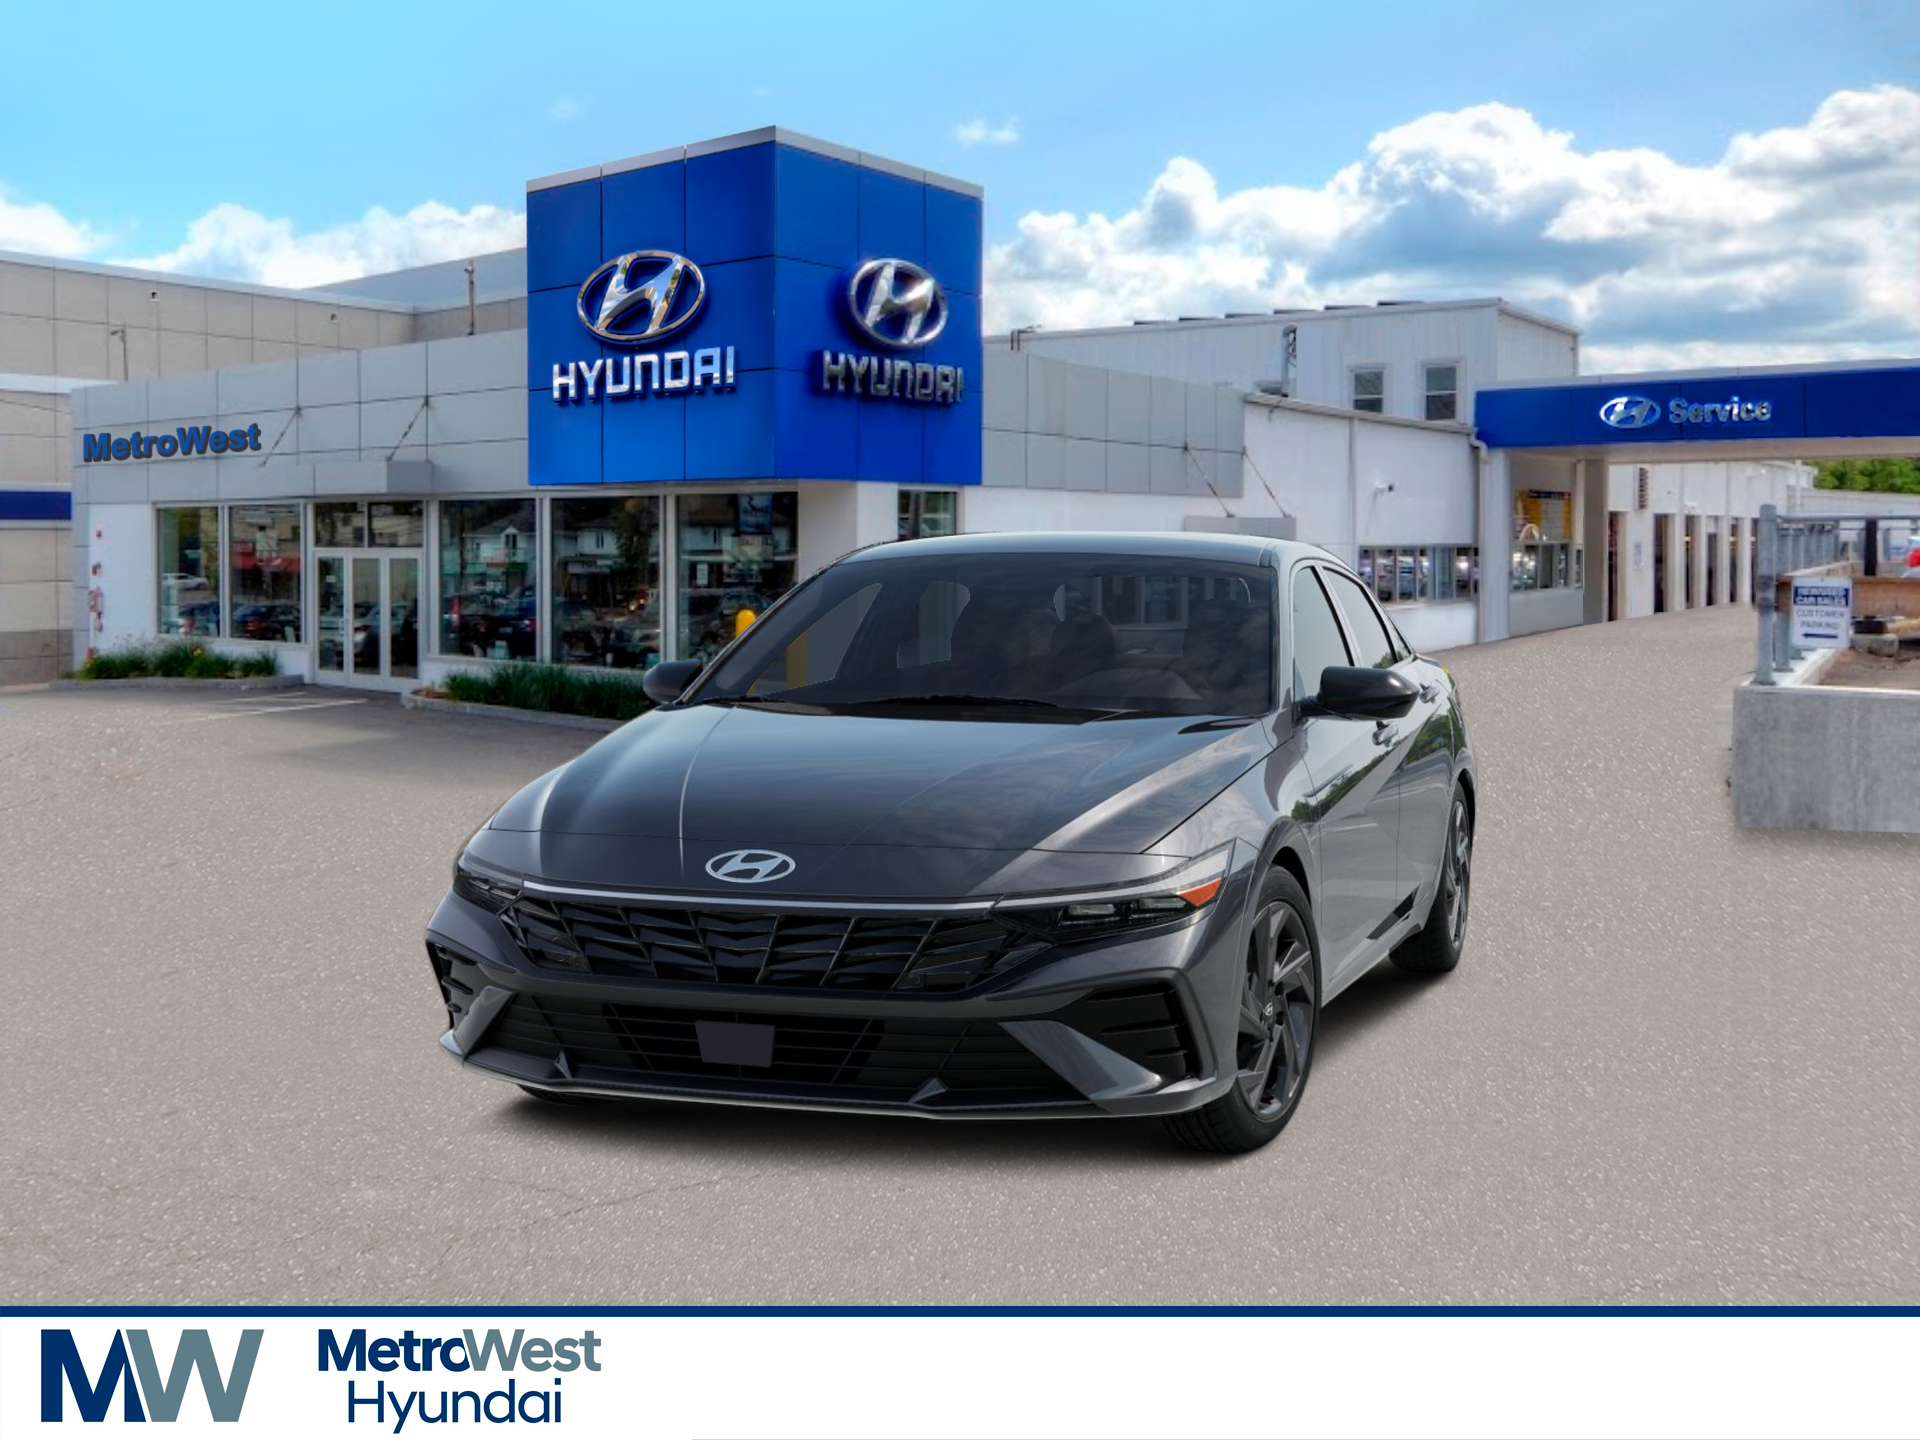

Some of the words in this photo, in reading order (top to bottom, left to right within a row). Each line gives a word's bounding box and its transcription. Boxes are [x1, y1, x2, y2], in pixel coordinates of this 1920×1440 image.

[553, 346, 735, 400] HYUNDAI
[822, 350, 964, 402] HYUNDAI
[1668, 396, 1772, 424] Service
[83, 423, 262, 463] MetroWest
[1796, 609, 1845, 618] CUSTOMER
